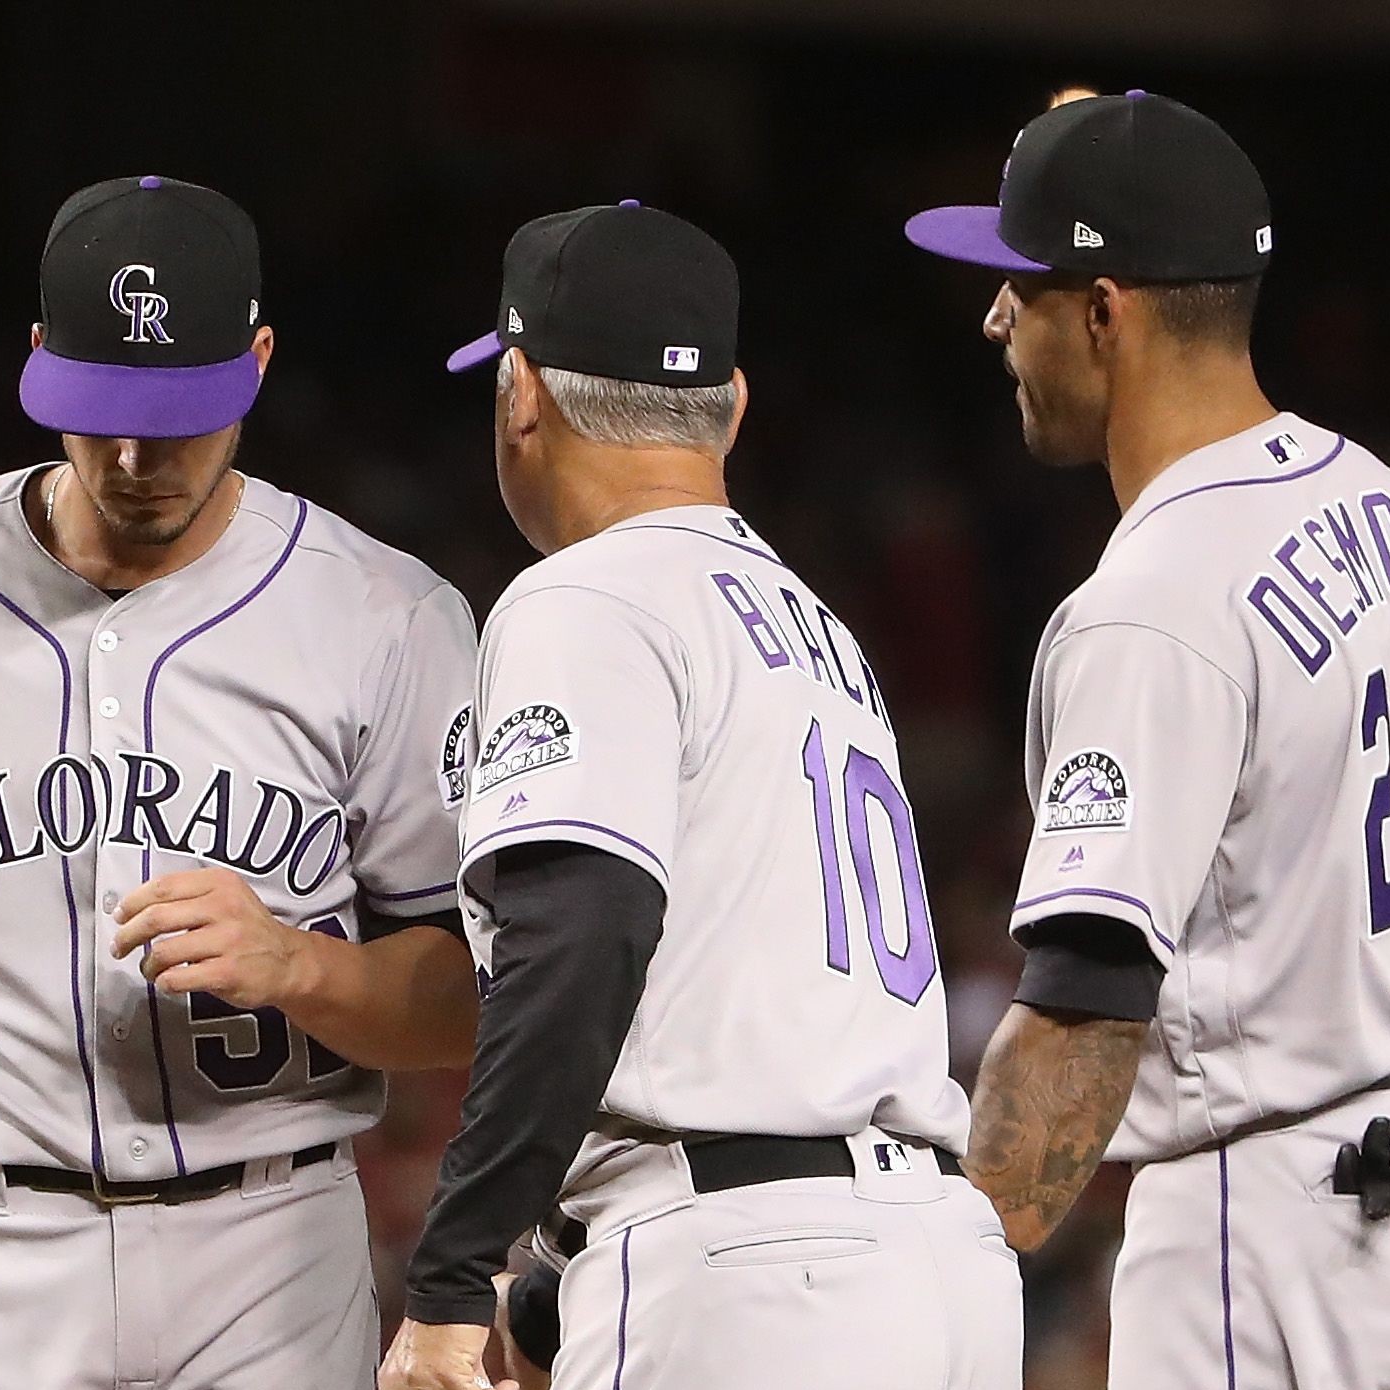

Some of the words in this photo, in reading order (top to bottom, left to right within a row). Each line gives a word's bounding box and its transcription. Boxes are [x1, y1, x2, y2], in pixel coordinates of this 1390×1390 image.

[483, 705, 567, 760] COLORADO
[479, 735, 572, 790] ROCKIES
[1050, 752, 1124, 795] COLORADO
[1046, 800, 1127, 829] ROCKIES
[800, 714, 938, 1009] 10
